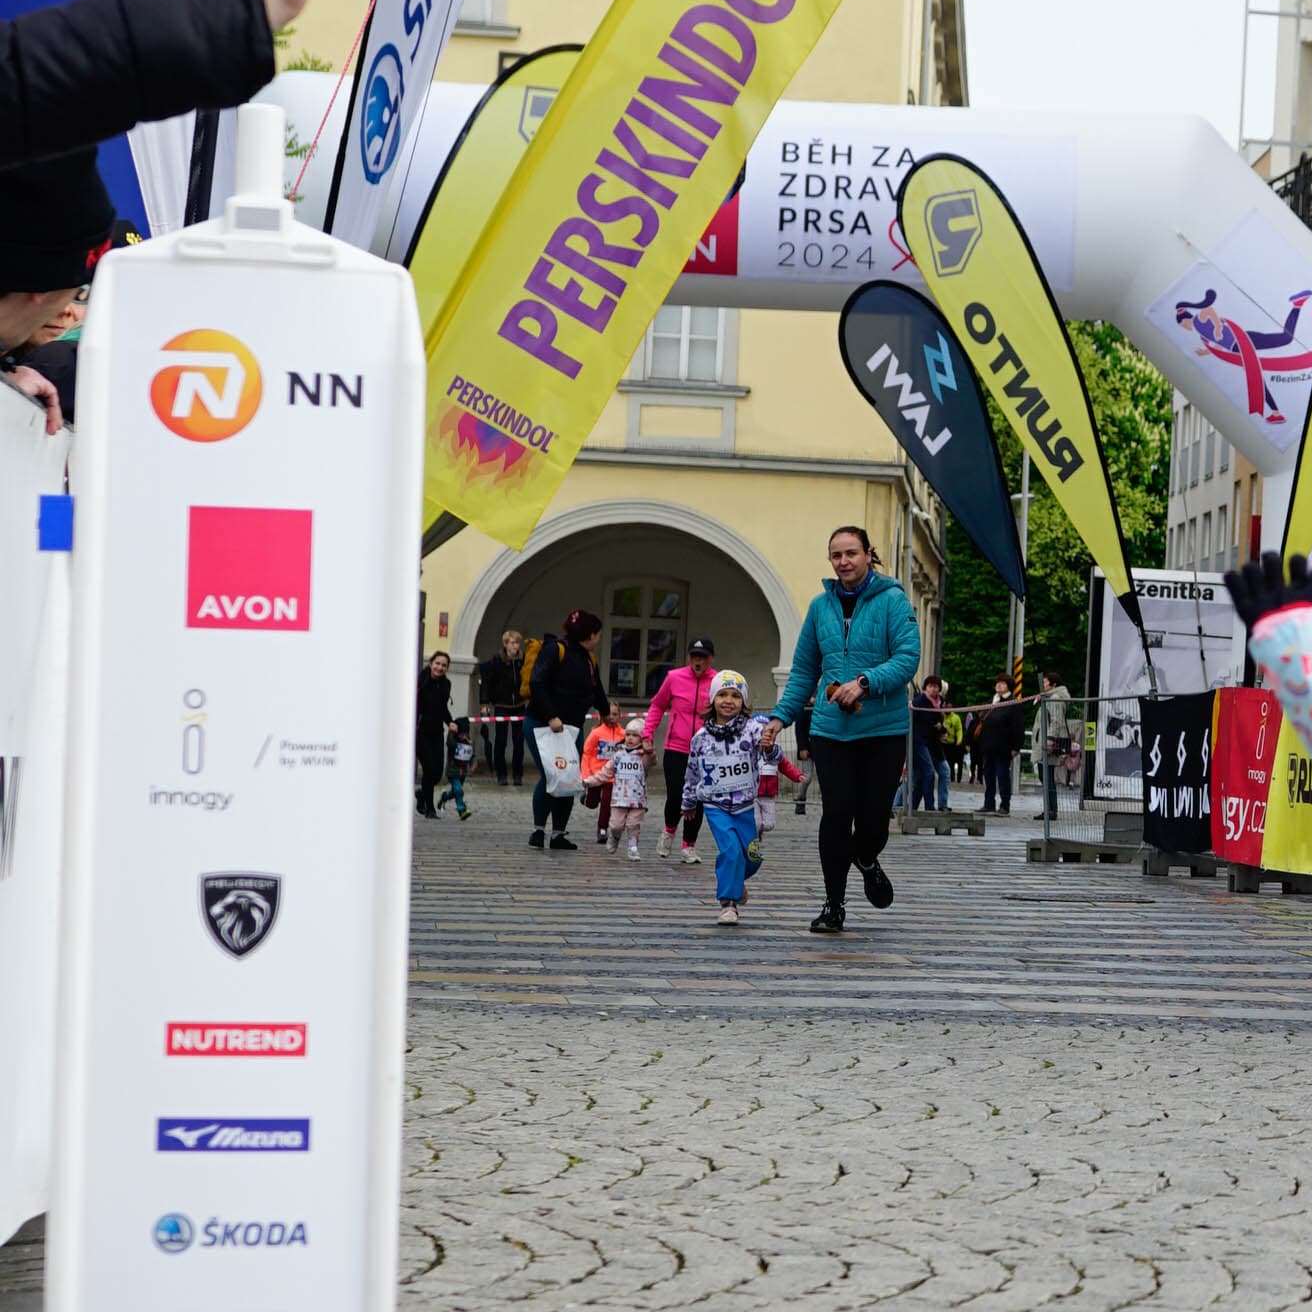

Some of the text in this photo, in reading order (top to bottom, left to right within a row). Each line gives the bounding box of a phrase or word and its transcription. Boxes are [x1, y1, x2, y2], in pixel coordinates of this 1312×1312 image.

[781, 138, 916, 168] BĚH ZA
[777, 173, 901, 202] ZDRAV
[778, 207, 872, 236] PRSA
[777, 241, 876, 271] 2024
[286, 372, 364, 408] NN
[446, 374, 557, 455] PERSKINDOL
[1136, 580, 1215, 601] ženitba
[197, 594, 299, 621] AVON
[719, 761, 750, 778] 3169
[150, 785, 234, 811] innogy
[171, 1028, 302, 1051] NUTREND
[201, 1217, 309, 1248] ŠKODA
